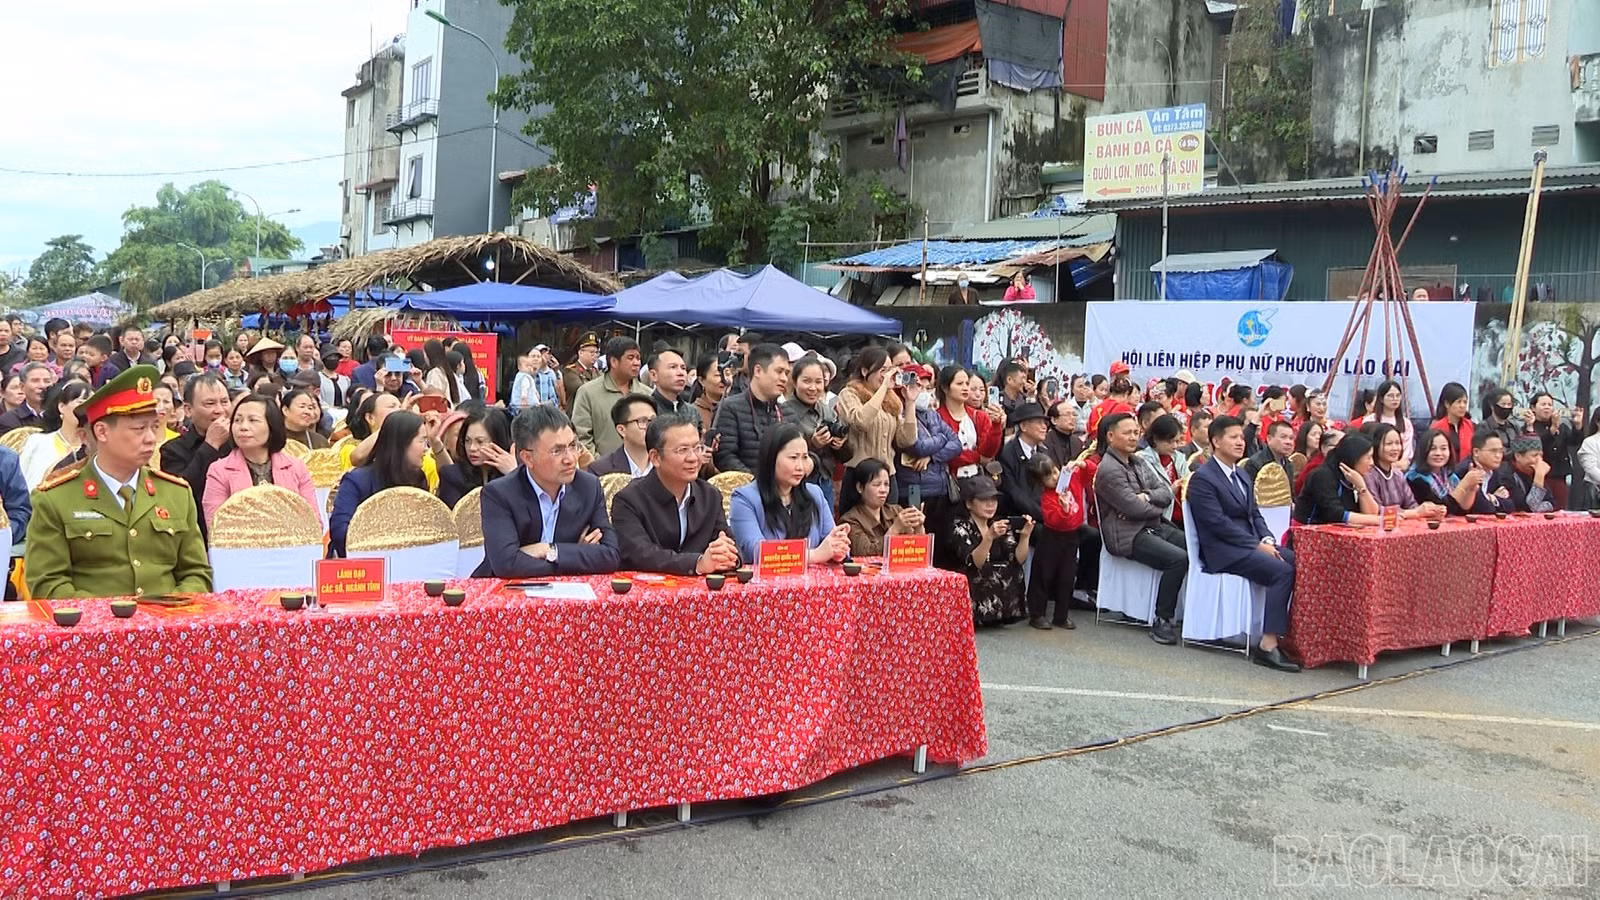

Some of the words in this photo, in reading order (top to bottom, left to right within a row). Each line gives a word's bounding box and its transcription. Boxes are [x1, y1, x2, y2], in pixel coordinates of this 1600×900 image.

[1097, 120, 1122, 137] BÚN
[1126, 115, 1143, 133] CÁ
[1152, 109, 1169, 123] An
[1174, 107, 1203, 121] Tâm
[1096, 141, 1130, 158] BÁNH
[1133, 140, 1151, 155] ĐA
[1155, 136, 1173, 153] CÁ
[1135, 162, 1157, 179] MỌC,
[1122, 349, 1143, 369] HỘI
[1147, 350, 1175, 367] LIÊN
[1180, 351, 1211, 371] HIỆP
[1216, 354, 1245, 374] PHỤ
[1250, 353, 1273, 371] NỮ
